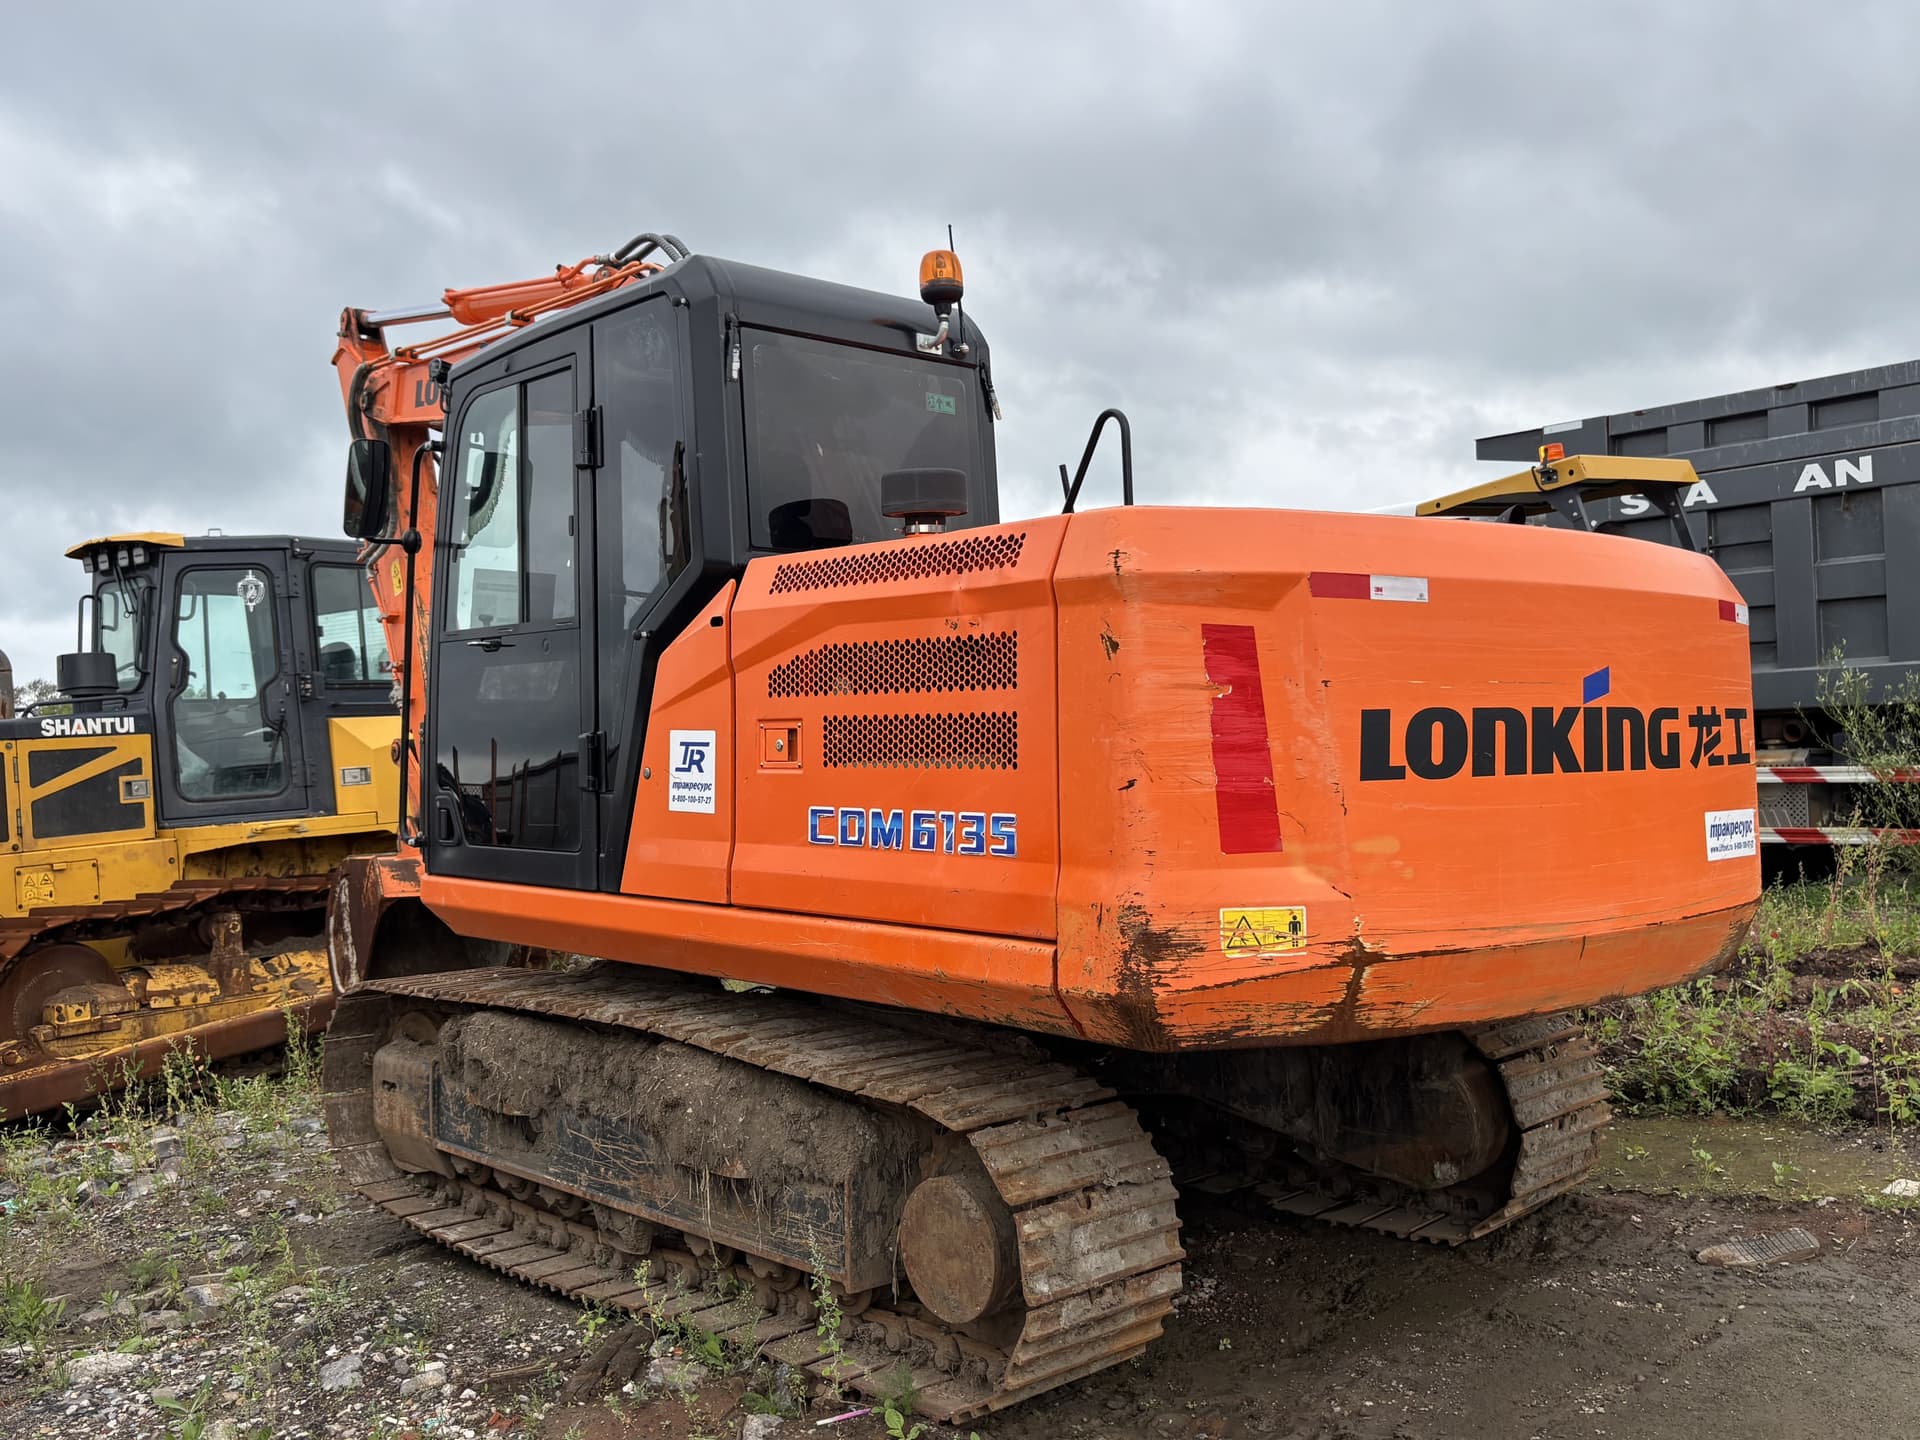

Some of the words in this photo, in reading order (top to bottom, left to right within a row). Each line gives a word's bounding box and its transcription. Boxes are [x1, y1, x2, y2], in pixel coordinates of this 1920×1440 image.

[415, 380, 439, 409] LO
[41, 717, 135, 737] SHANTUI
[1687, 705, 1750, 769] 龙工
[672, 781, 713, 792] тракресурс
[1710, 819, 1753, 841] тракресурс
